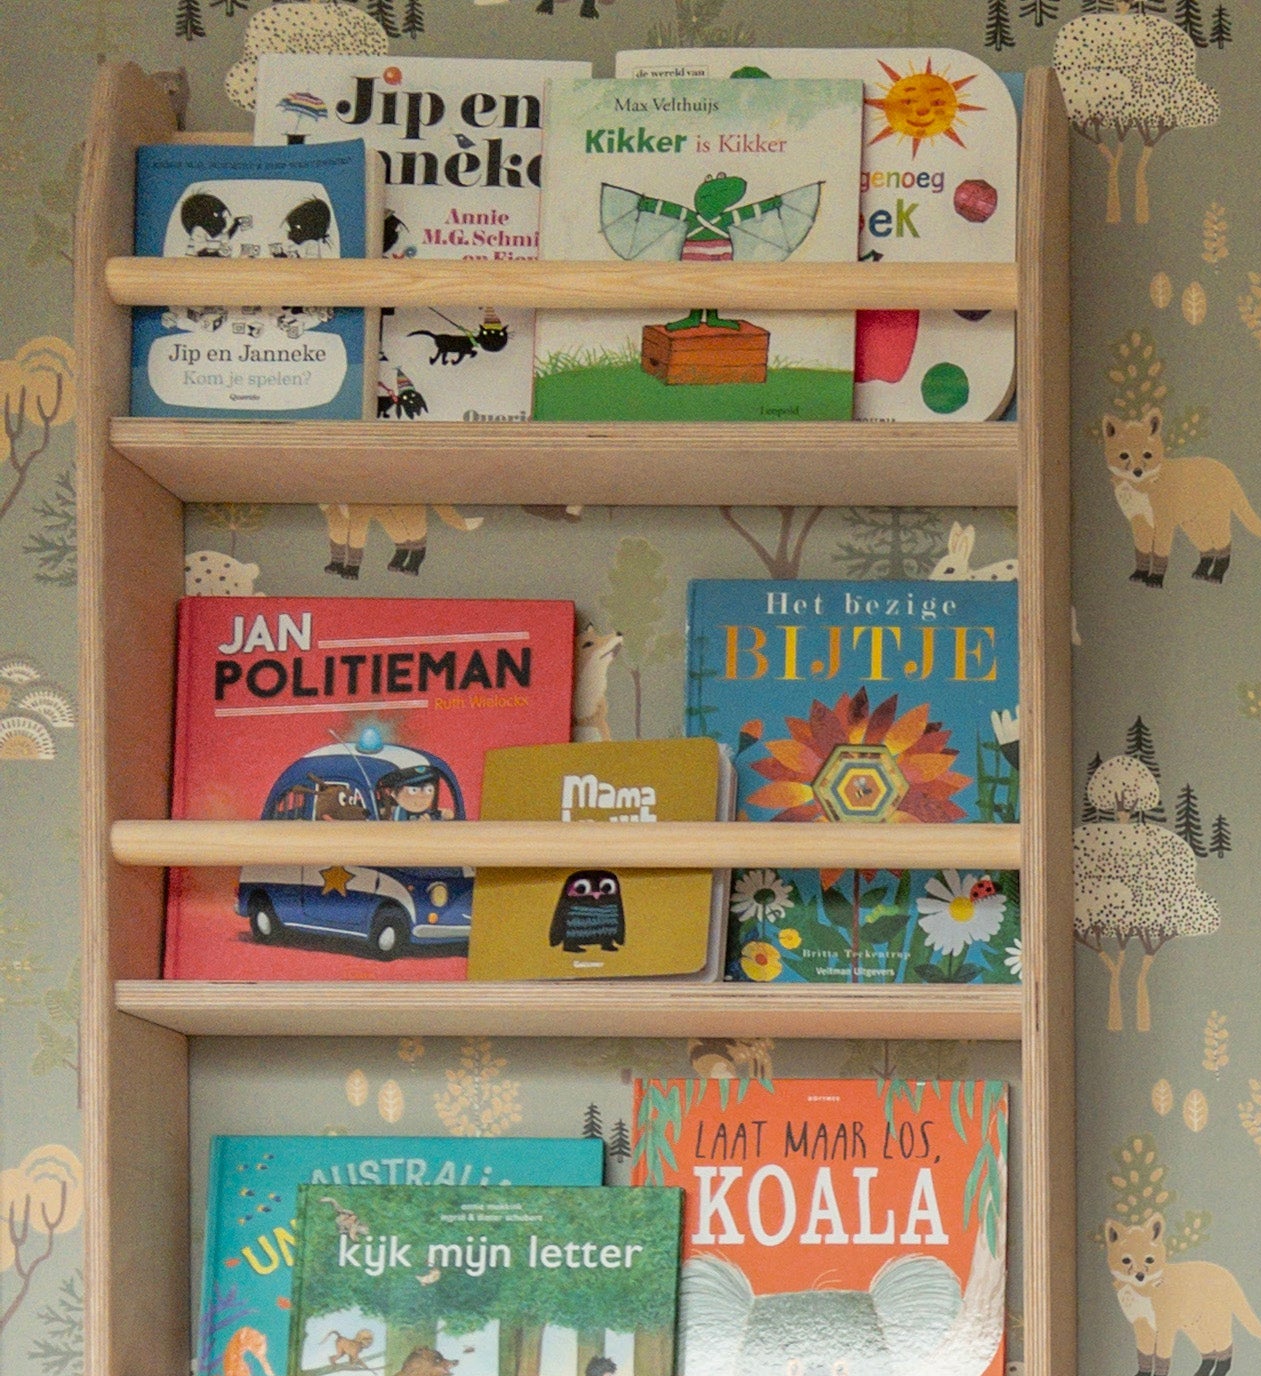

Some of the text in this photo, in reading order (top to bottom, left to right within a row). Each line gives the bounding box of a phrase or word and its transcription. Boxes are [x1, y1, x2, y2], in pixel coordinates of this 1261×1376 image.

[651, 67, 685, 77] wereld
[335, 67, 542, 139] Jip en
[614, 97, 720, 115] Max Velthuijs
[585, 127, 788, 153] Kikker is Kikker
[860, 170, 945, 193] genoeg
[444, 208, 510, 226] Annie
[422, 228, 470, 246] M.G.
[168, 344, 326, 365] Jip en Janneke
[183, 371, 312, 388] Kom je spelen?
[463, 409, 532, 422] Queri
[766, 591, 957, 621] Het bezige
[218, 612, 312, 655] JAN
[718, 624, 998, 682] BIJTJE
[214, 647, 531, 701] POLITIEMAN
[562, 774, 656, 808] Mama
[694, 1120, 941, 1164] LAAT MAAR LOS,
[691, 1164, 949, 1247] KOALA
[338, 1234, 643, 1277] kijk mijn letter
